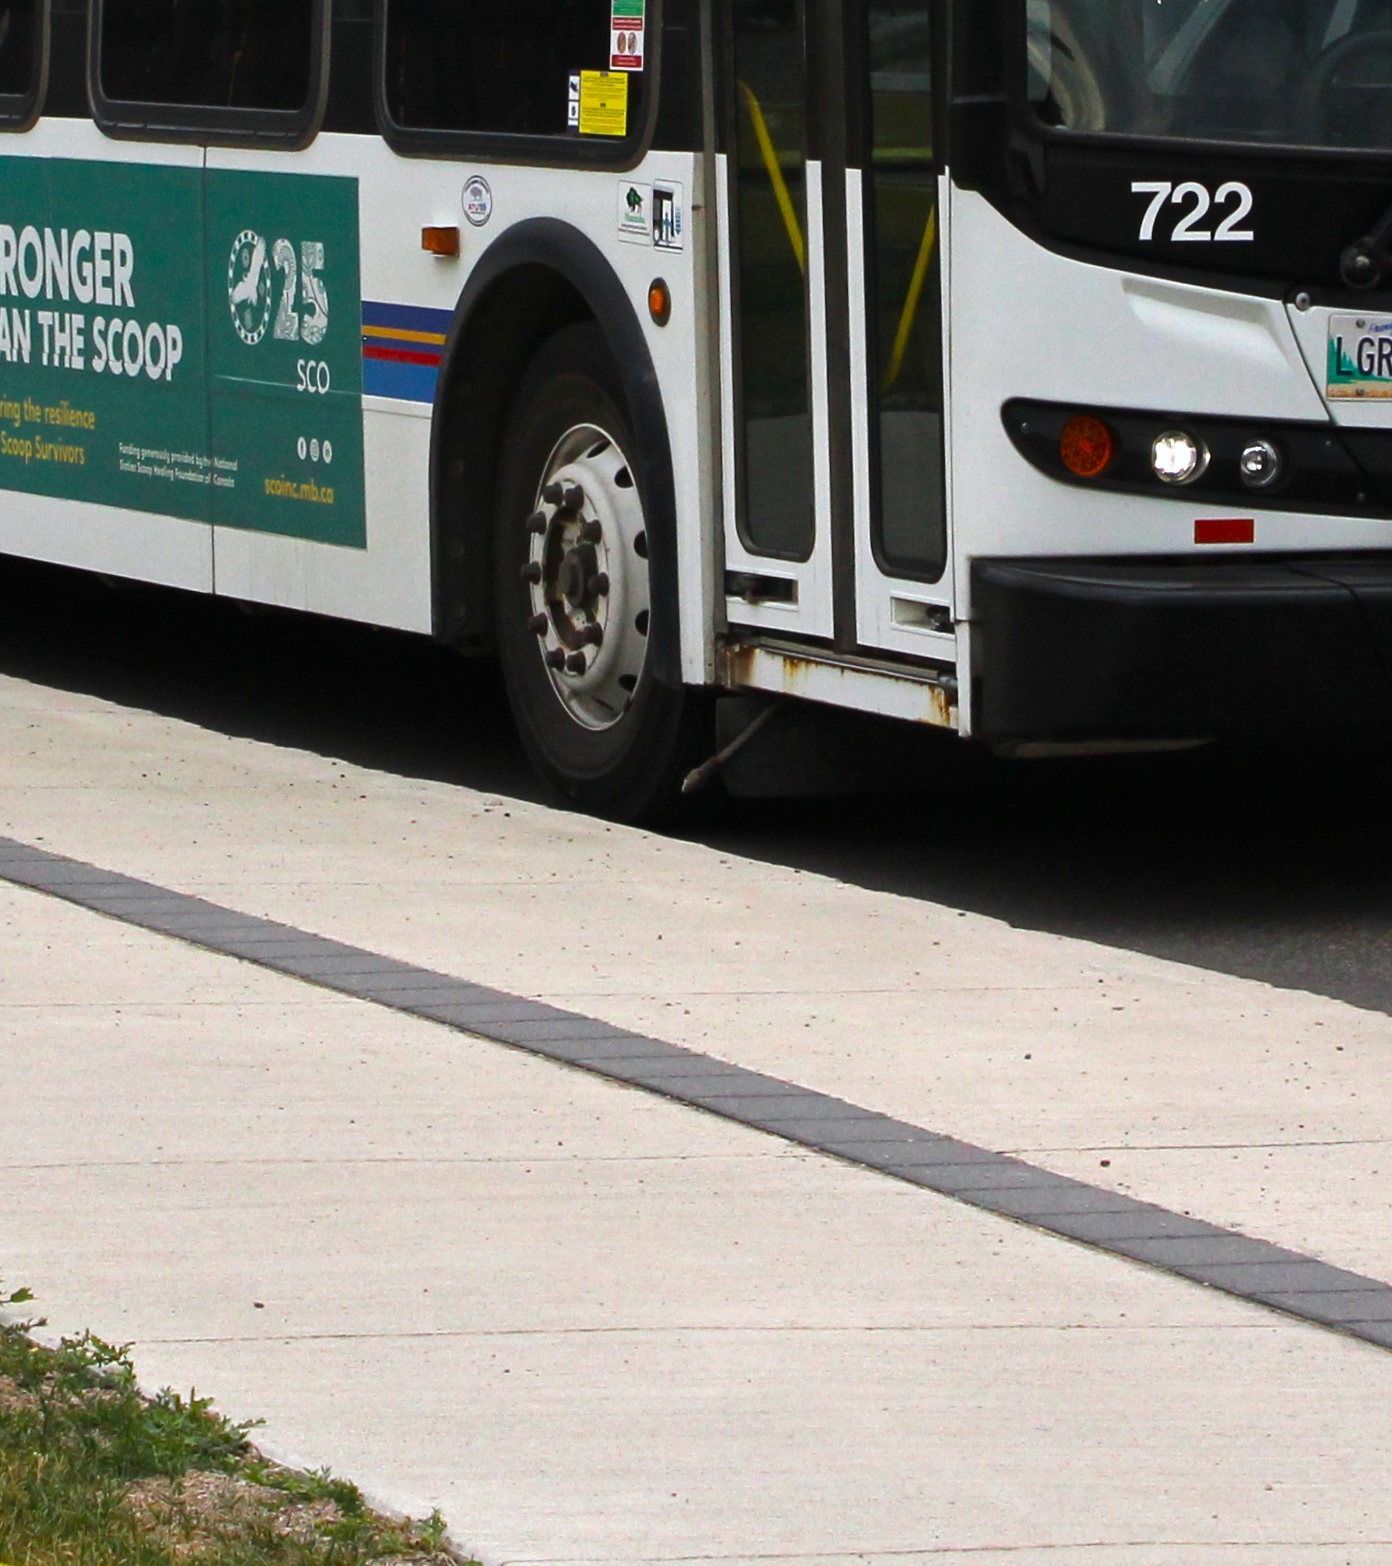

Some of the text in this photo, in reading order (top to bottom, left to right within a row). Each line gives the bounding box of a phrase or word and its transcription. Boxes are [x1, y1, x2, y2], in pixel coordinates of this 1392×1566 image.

[1131, 182, 1255, 241] 722
[37, 310, 85, 371] THE
[92, 315, 184, 382] SCOOP
[296, 358, 331, 395] SCO
[23, 396, 42, 423] the
[44, 399, 96, 430] resilience
[0, 430, 33, 465] Scoop
[34, 434, 86, 466] Survivors
